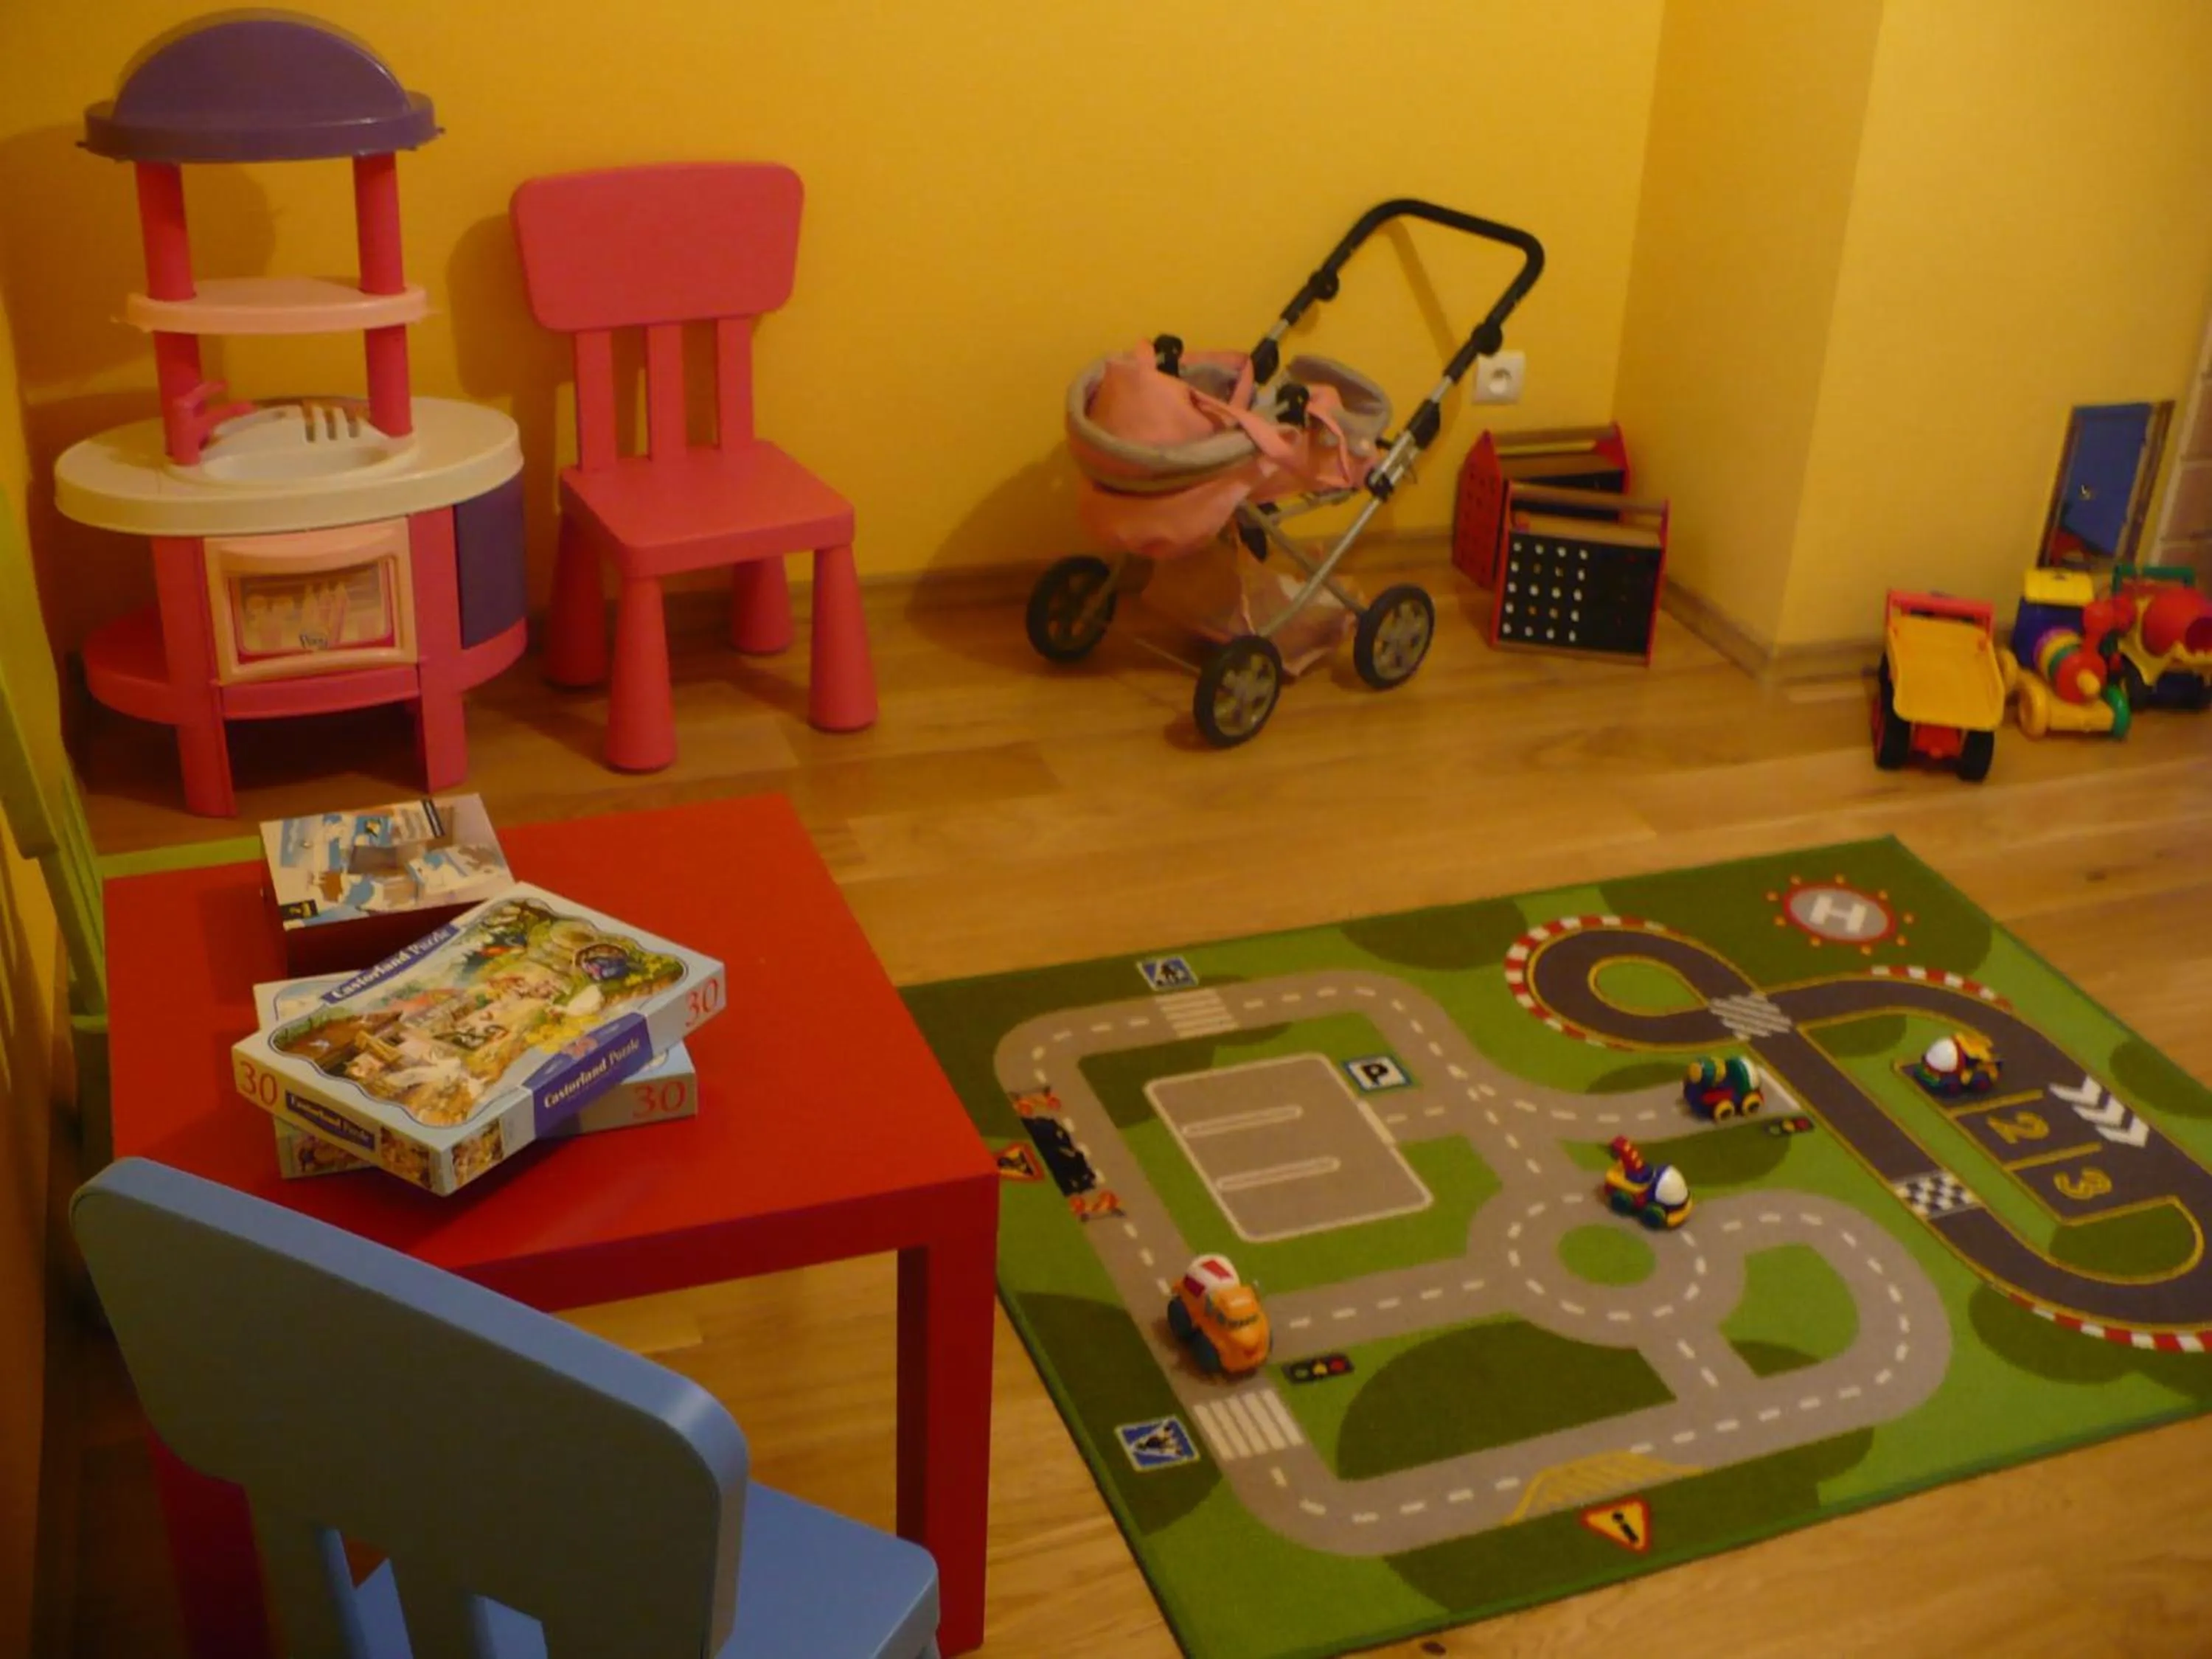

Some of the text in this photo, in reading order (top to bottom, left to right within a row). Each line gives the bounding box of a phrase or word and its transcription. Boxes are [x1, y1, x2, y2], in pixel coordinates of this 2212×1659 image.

[1809, 894, 1867, 933] H
[684, 978, 719, 1029] 30
[240, 1060, 278, 1106] 30
[544, 1057, 607, 1109] Castorland
[1361, 1062, 1389, 1086] P
[632, 1080, 686, 1118] 30
[1986, 1110, 2051, 1144] 2
[2053, 1167, 2113, 1200] 3
